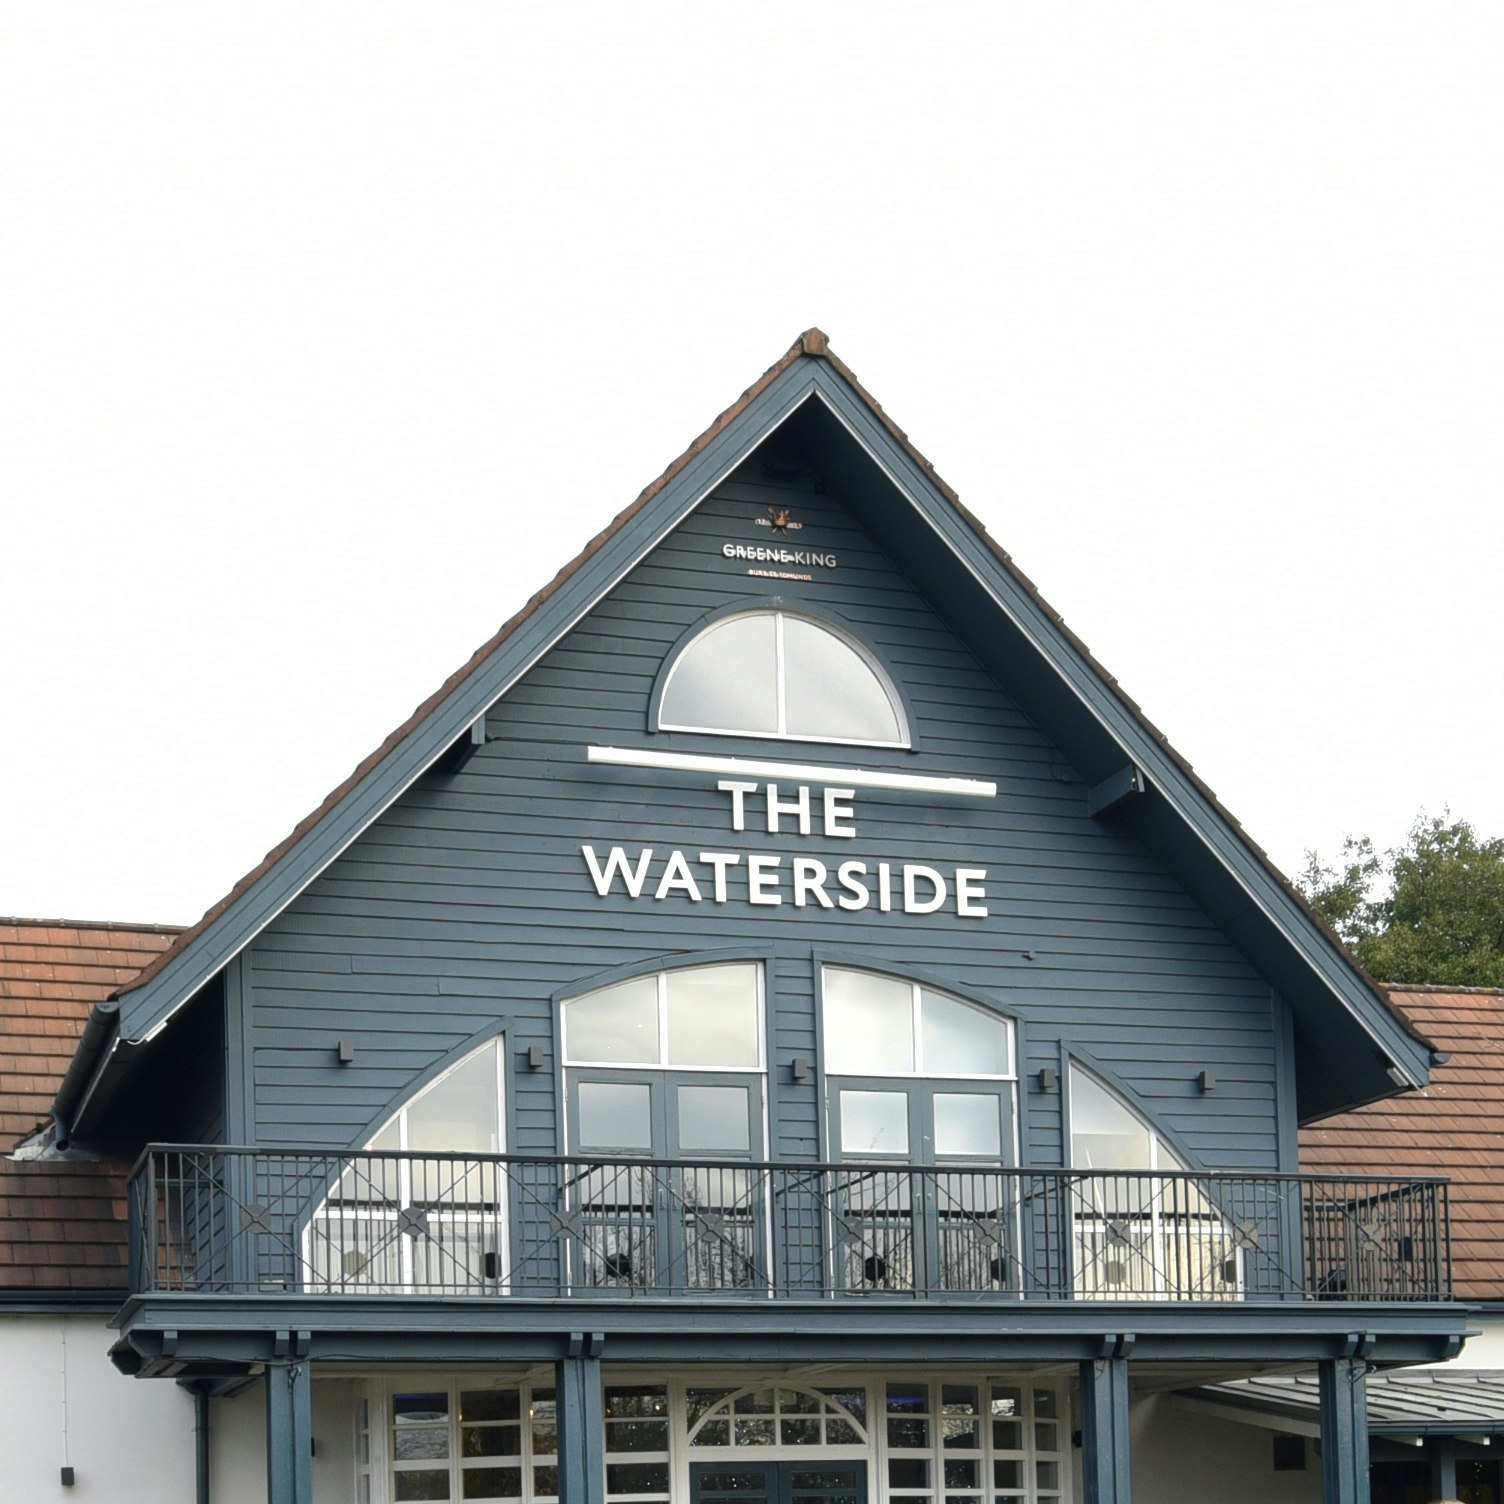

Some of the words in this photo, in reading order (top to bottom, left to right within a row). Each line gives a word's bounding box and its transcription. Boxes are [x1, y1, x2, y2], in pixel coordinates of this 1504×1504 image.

[723, 544, 789, 563] GREENE
[795, 551, 837, 568] KING
[718, 780, 856, 838] THE
[582, 845, 989, 917] WATERSIDE
